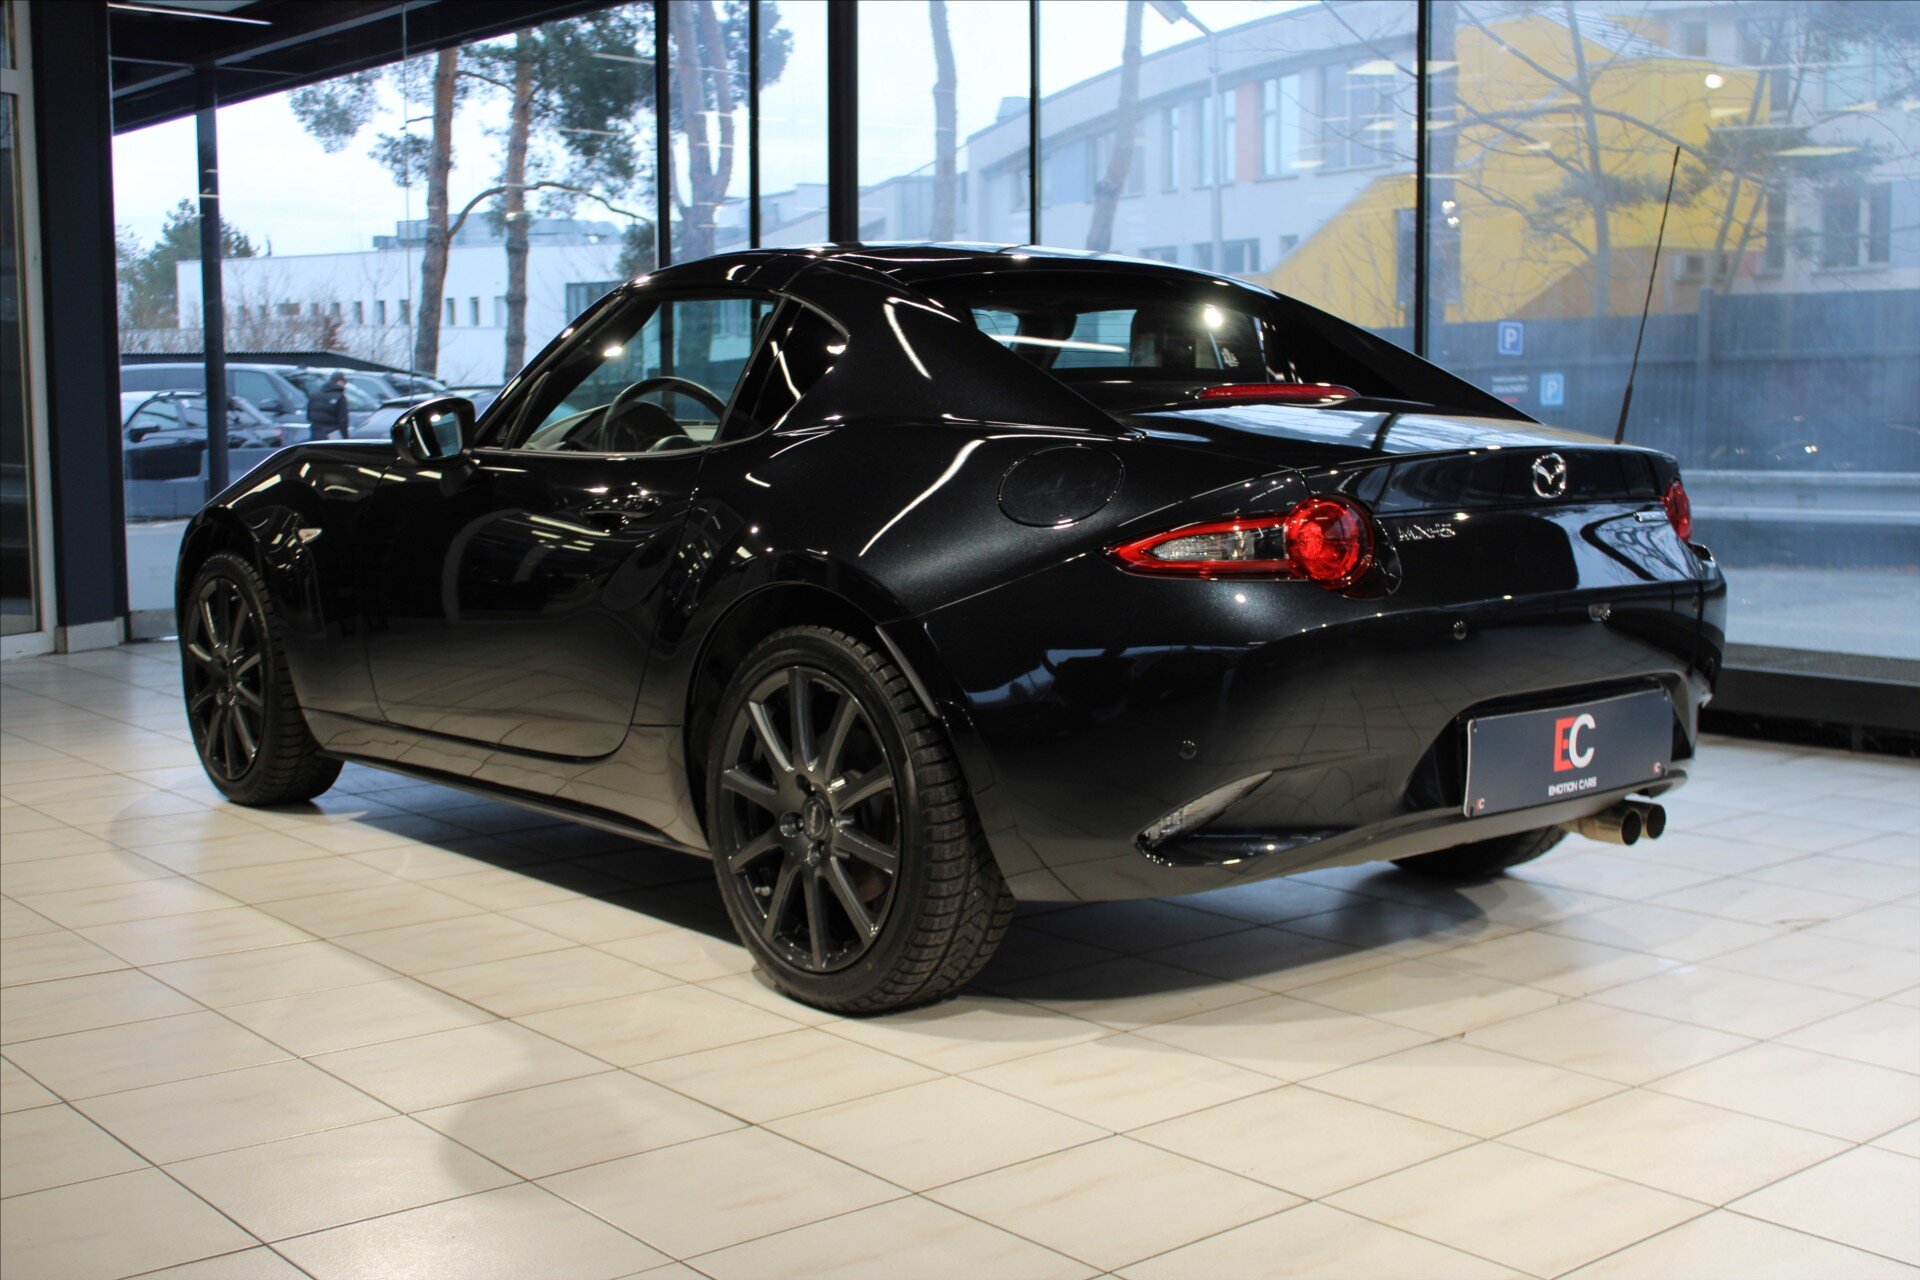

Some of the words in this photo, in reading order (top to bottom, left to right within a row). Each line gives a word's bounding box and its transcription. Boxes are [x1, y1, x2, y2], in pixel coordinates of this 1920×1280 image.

[1504, 328, 1518, 349] P
[1547, 380, 1558, 398] P
[1553, 713, 1596, 773] EC
[1548, 780, 1578, 796] EMOTION
[1578, 776, 1597, 790] CARS
